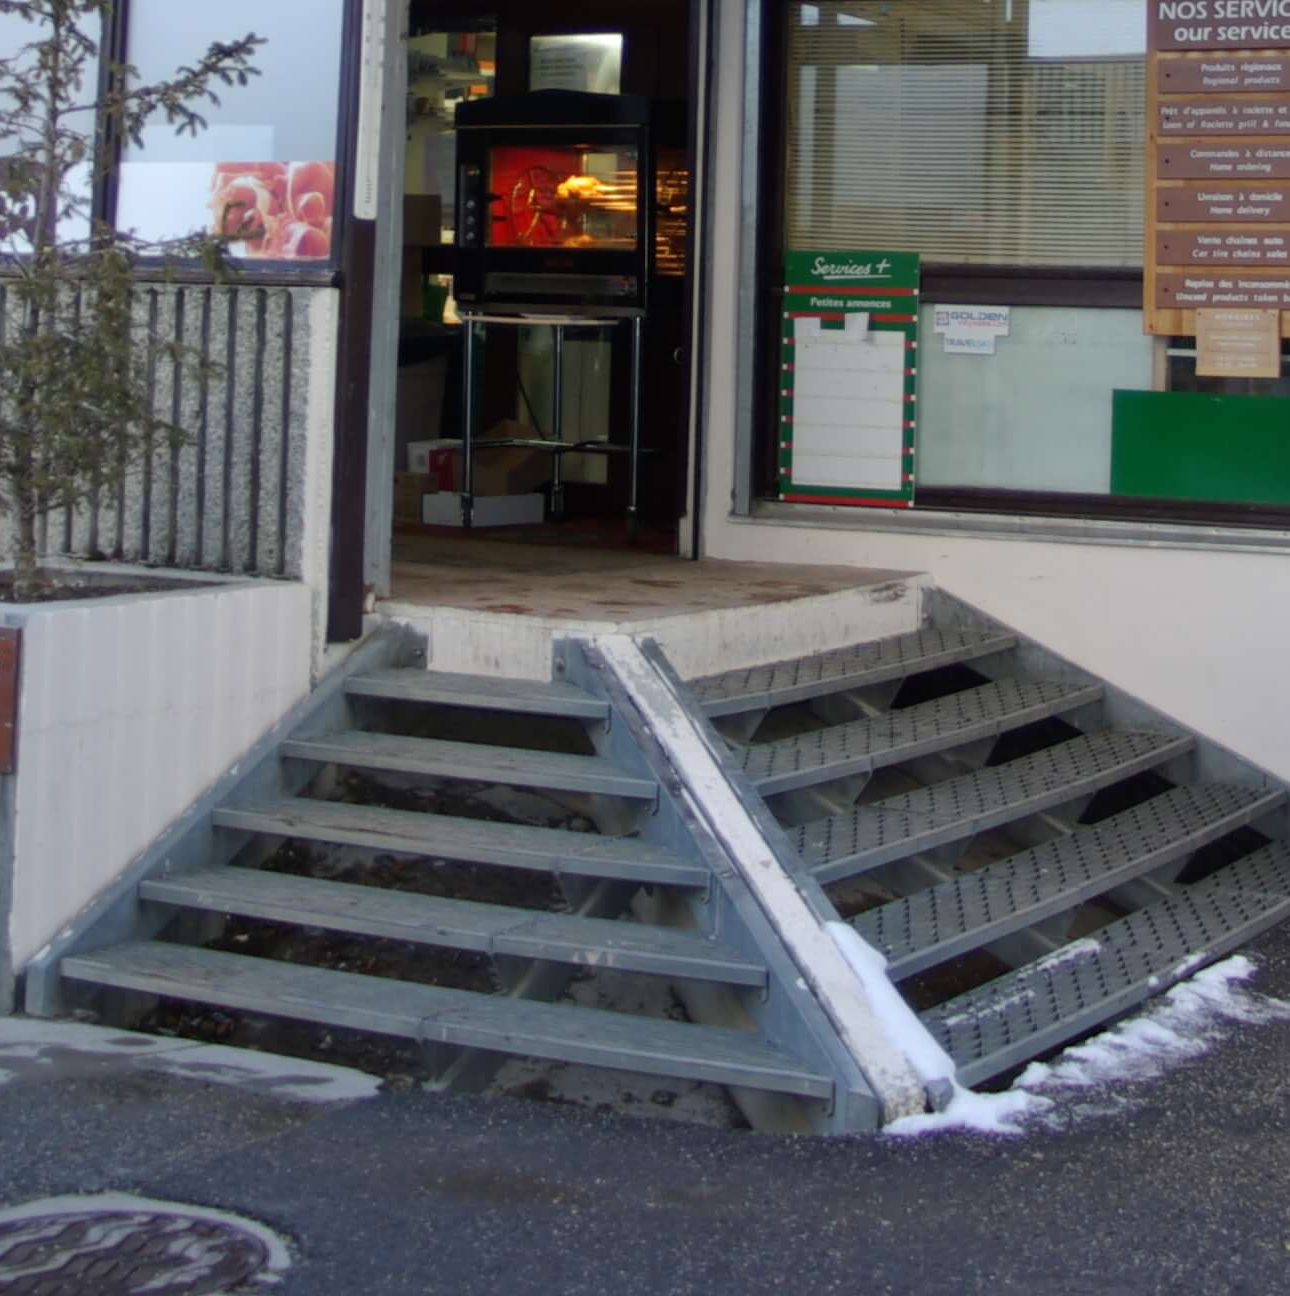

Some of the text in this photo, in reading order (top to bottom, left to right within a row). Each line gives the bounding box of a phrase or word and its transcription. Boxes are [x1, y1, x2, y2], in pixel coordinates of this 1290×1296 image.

[1159, 1, 1207, 20] NOS
[1174, 26, 1211, 42] our
[1201, 63, 1236, 73] Produits
[1192, 249, 1208, 258] Car
[810, 256, 871, 275] Services
[810, 296, 892, 309] Petites annonces
